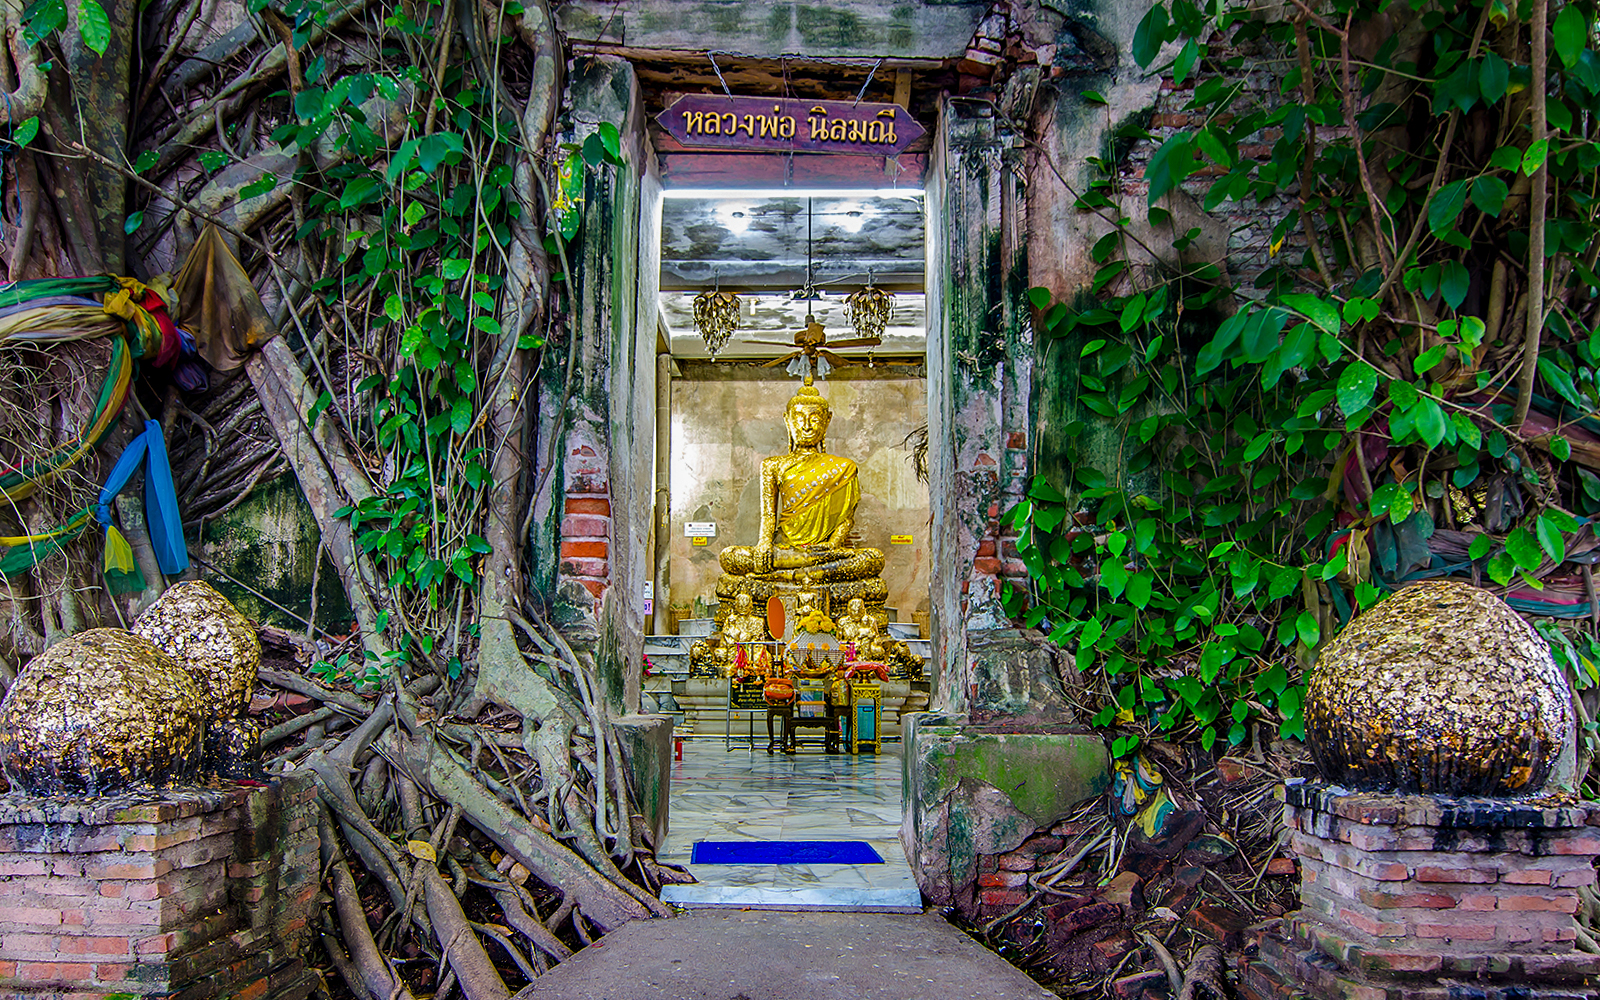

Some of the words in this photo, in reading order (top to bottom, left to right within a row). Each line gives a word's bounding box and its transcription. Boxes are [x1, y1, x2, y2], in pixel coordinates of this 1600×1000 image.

[683, 105, 796, 138] หลวงพ่อ
[807, 106, 898, 144] นิลมณี
